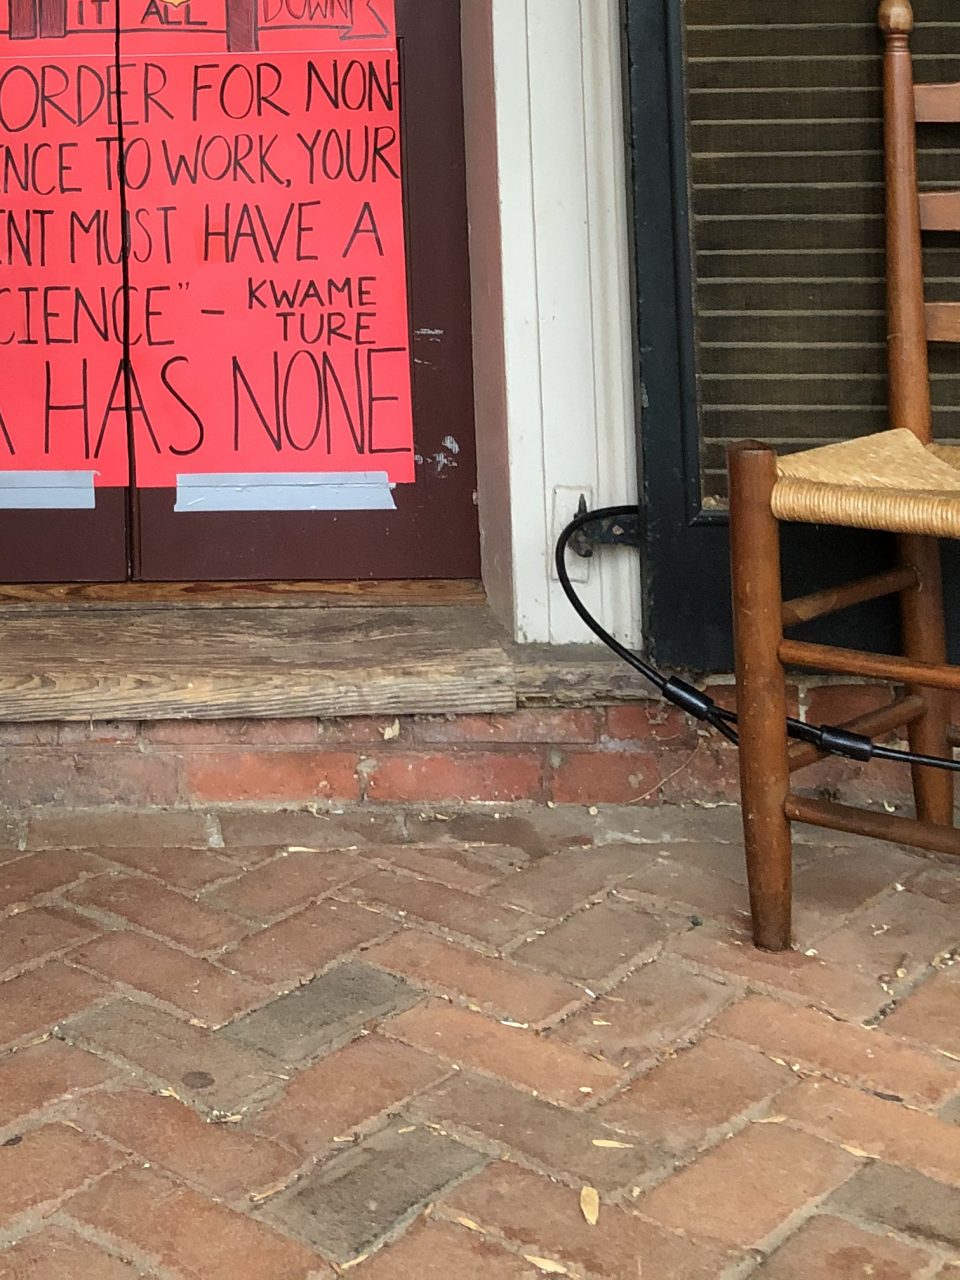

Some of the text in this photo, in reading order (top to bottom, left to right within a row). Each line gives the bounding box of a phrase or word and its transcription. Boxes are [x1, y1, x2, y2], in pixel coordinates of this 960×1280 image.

[192, 62, 290, 121] FOR
[95, 136, 151, 191] TO
[161, 134, 292, 188] WORK,
[296, 125, 401, 185] YOUR
[69, 205, 177, 266] MUST
[203, 200, 321, 263] HAVE
[342, 201, 385, 258] A
[248, 277, 377, 310] KWAME
[275, 311, 377, 346] TURE
[44, 355, 205, 460] HAS
[231, 346, 412, 455] NONE
